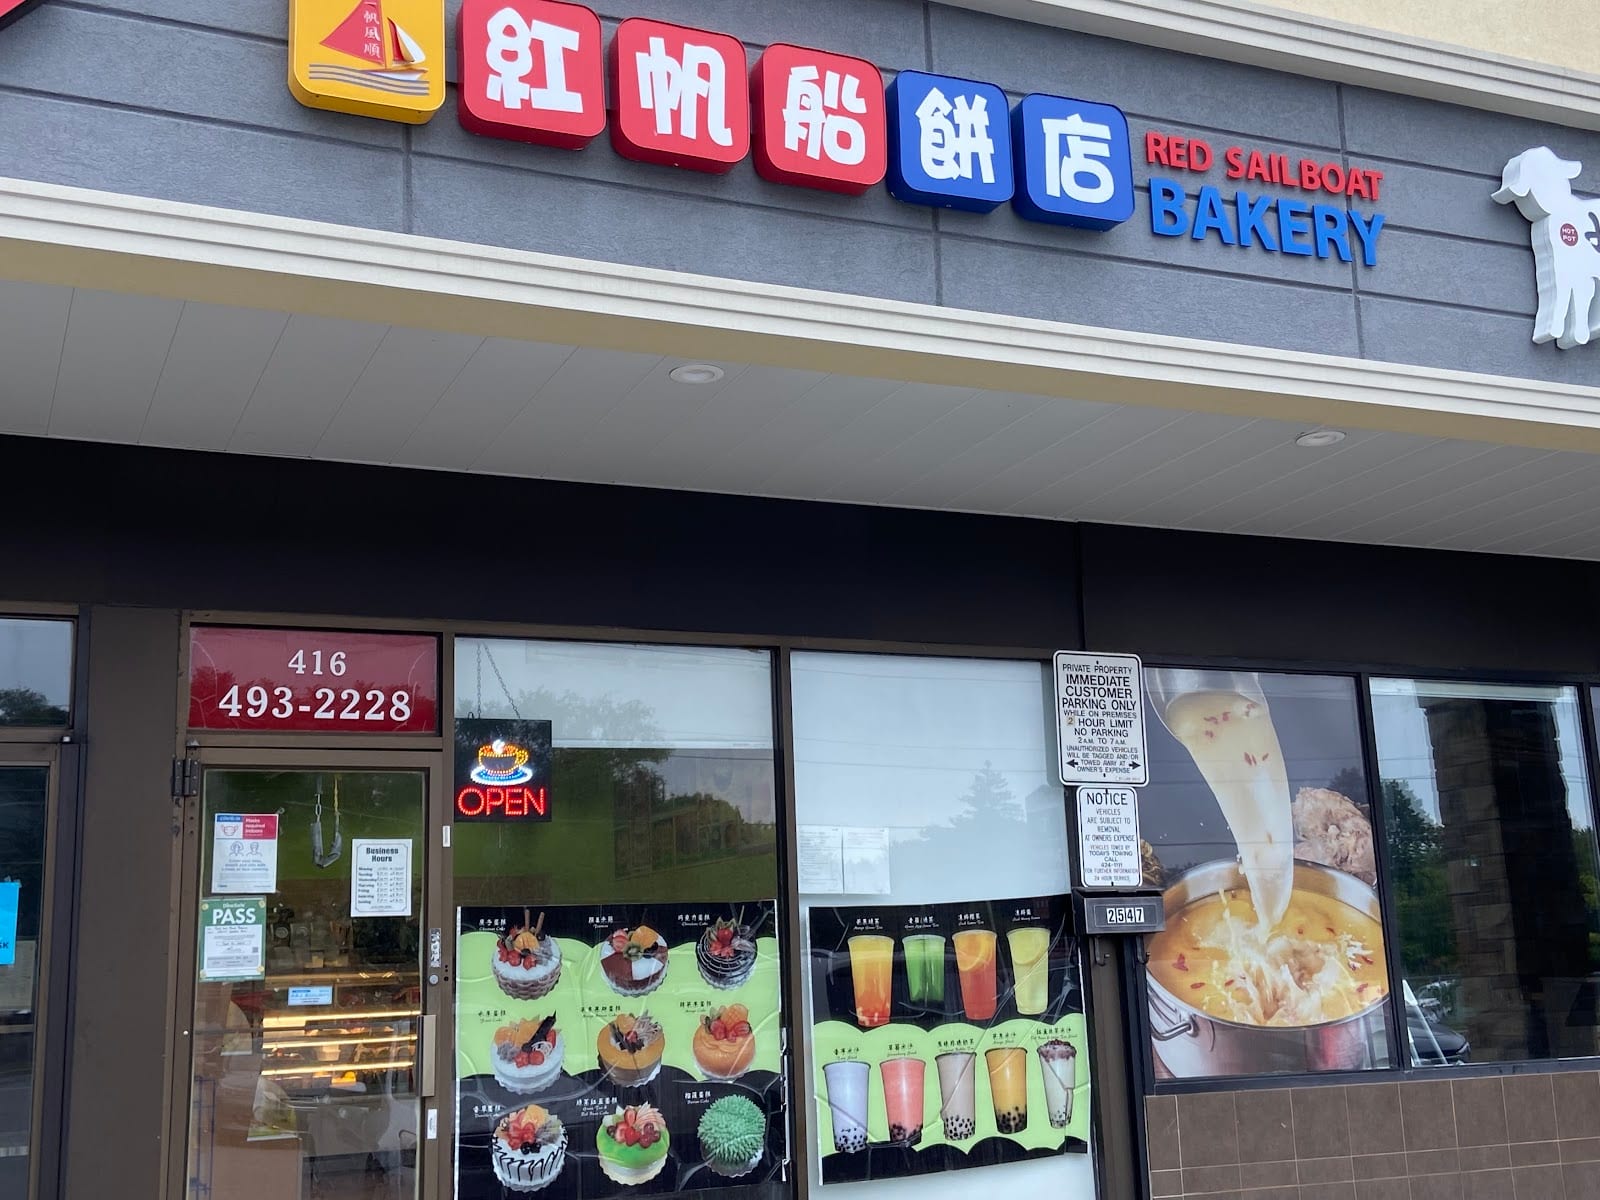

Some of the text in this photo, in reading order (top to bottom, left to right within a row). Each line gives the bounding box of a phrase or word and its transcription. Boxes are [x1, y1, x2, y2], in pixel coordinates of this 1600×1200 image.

[363, 1, 381, 58] 一帆風順
[486, 7, 1115, 203] 紅帆船餅店
[1146, 131, 1213, 172] RED
[1149, 177, 1385, 266] BAKERY
[287, 649, 347, 677] 416
[1062, 664, 1132, 674] PRIVATE PROPERTY
[1066, 674, 1130, 687] IMMEDIATE
[1065, 686, 1133, 699] CUSTOMER
[218, 685, 411, 721] 493-2228
[1062, 697, 1137, 711] PARKING ONLY
[1064, 709, 1085, 717] WHILE
[1102, 711, 1137, 719] PREMISES
[1067, 717, 1133, 728] 2 HOUR LIMIT
[1074, 728, 1129, 737] NO PARKING
[457, 787, 545, 816] OPEN
[1086, 792, 1128, 805] NOTICE
[213, 908, 256, 925] PASS
[1108, 908, 1143, 923] 2547
